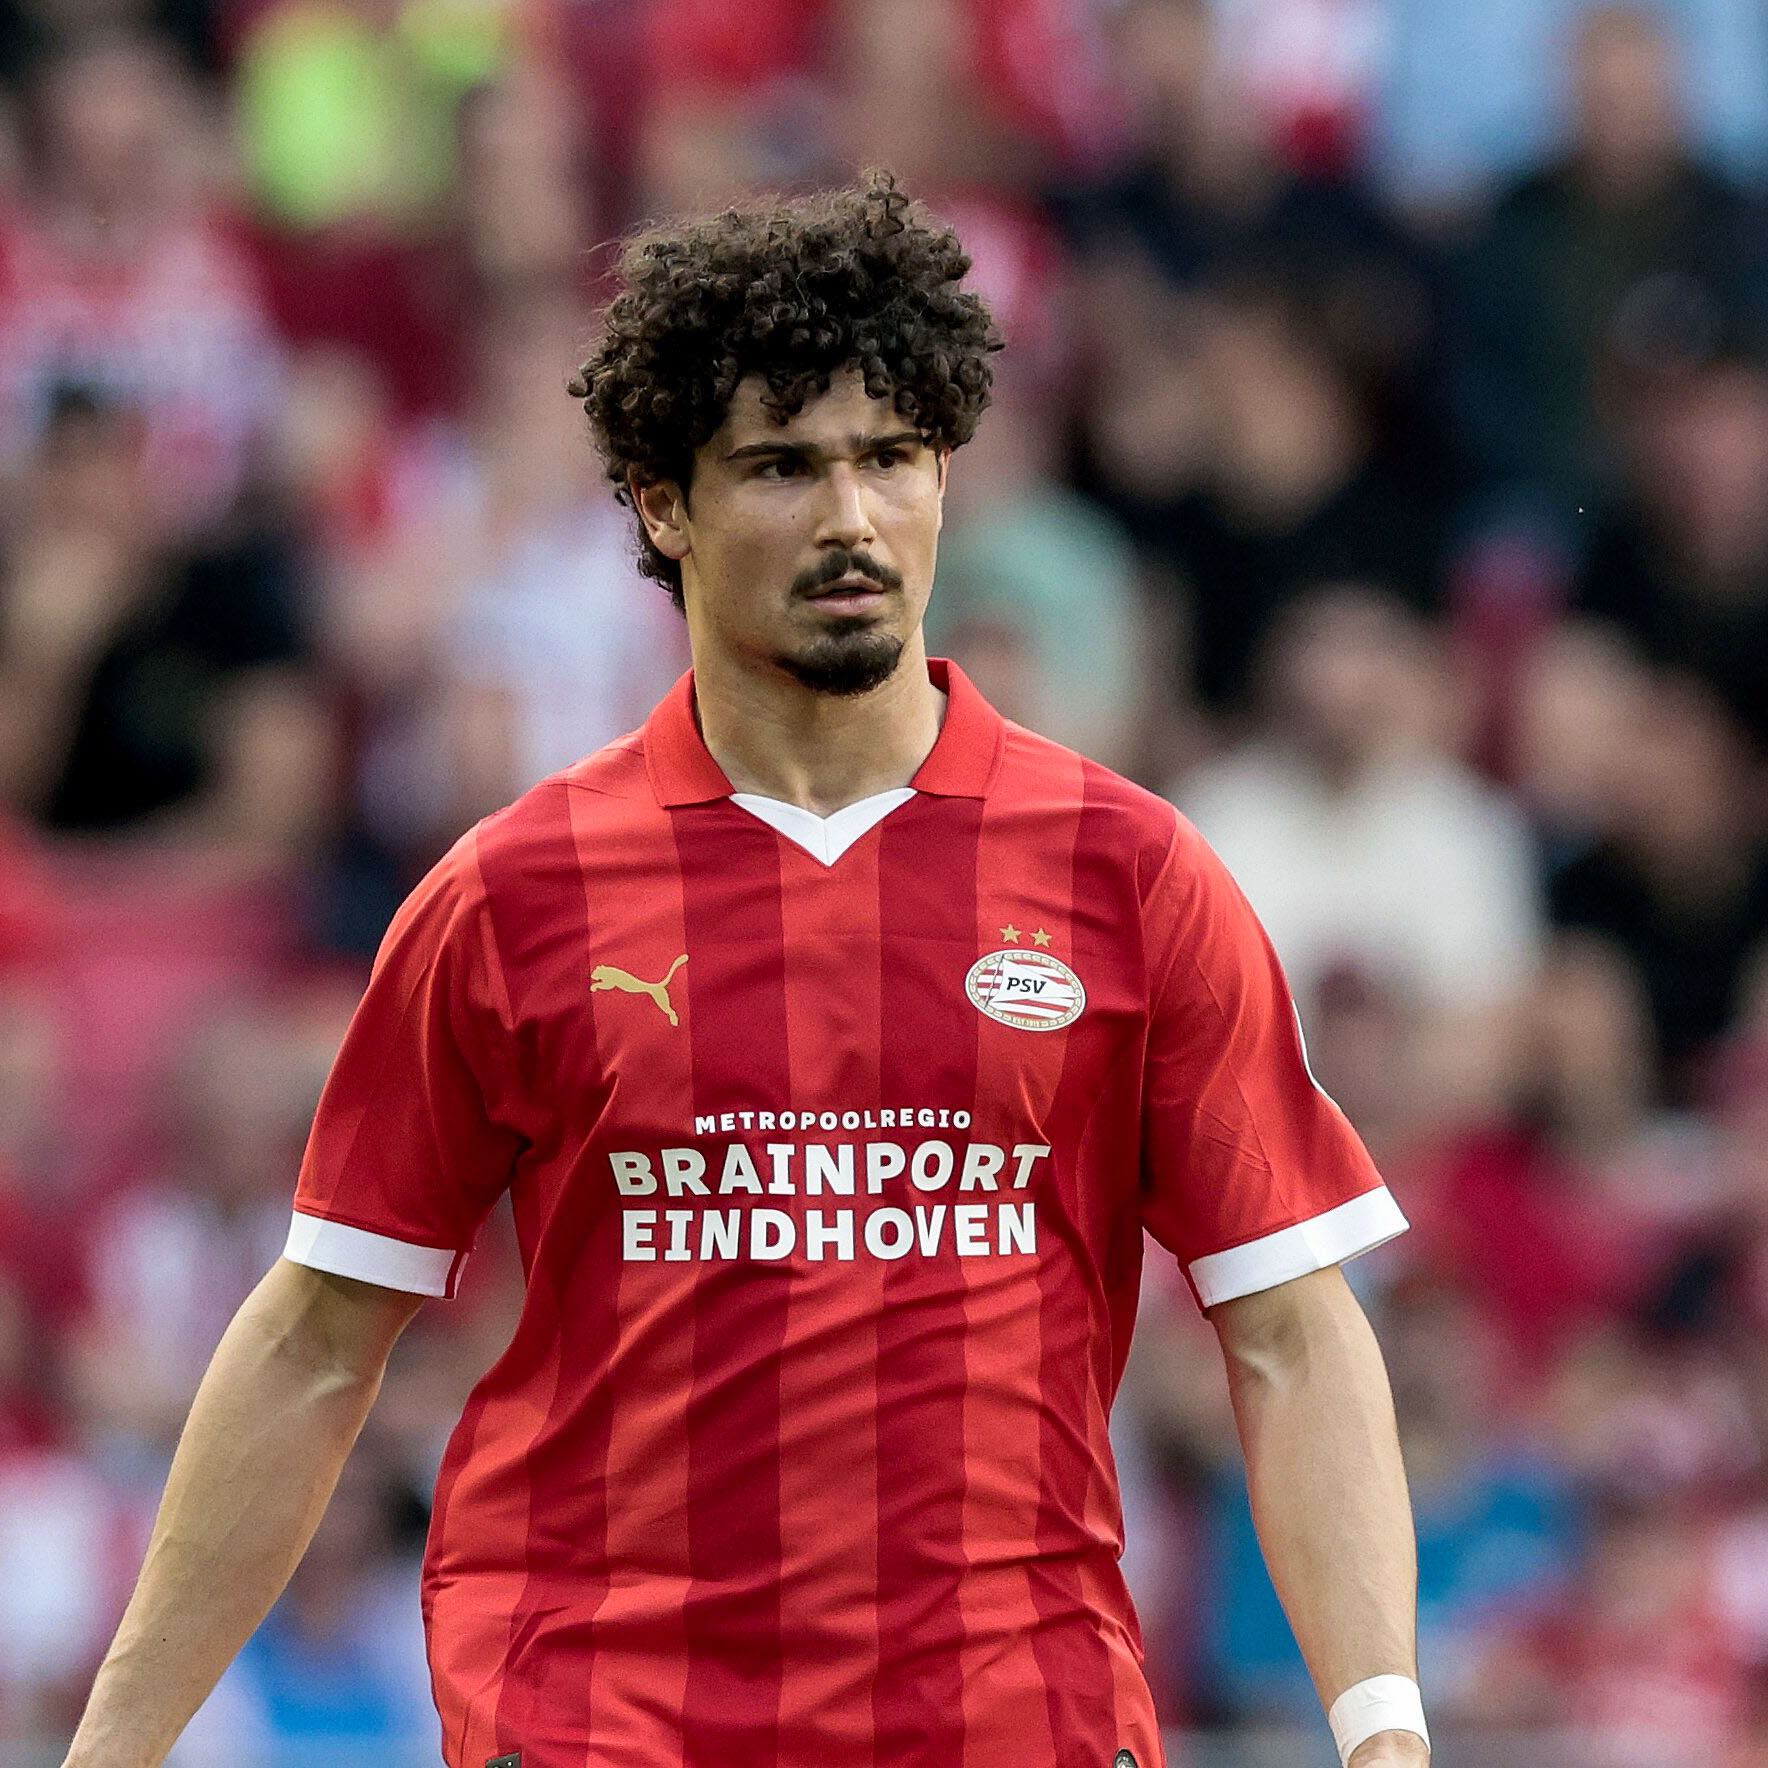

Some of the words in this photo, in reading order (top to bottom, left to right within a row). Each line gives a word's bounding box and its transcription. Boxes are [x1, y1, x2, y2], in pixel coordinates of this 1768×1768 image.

[1007, 977, 1046, 994] PSV
[695, 1108, 972, 1136] METROPOOLREGIO
[608, 1139, 1052, 1198] BRAINPORT
[621, 1202, 1039, 1263] EINDHOVEN
